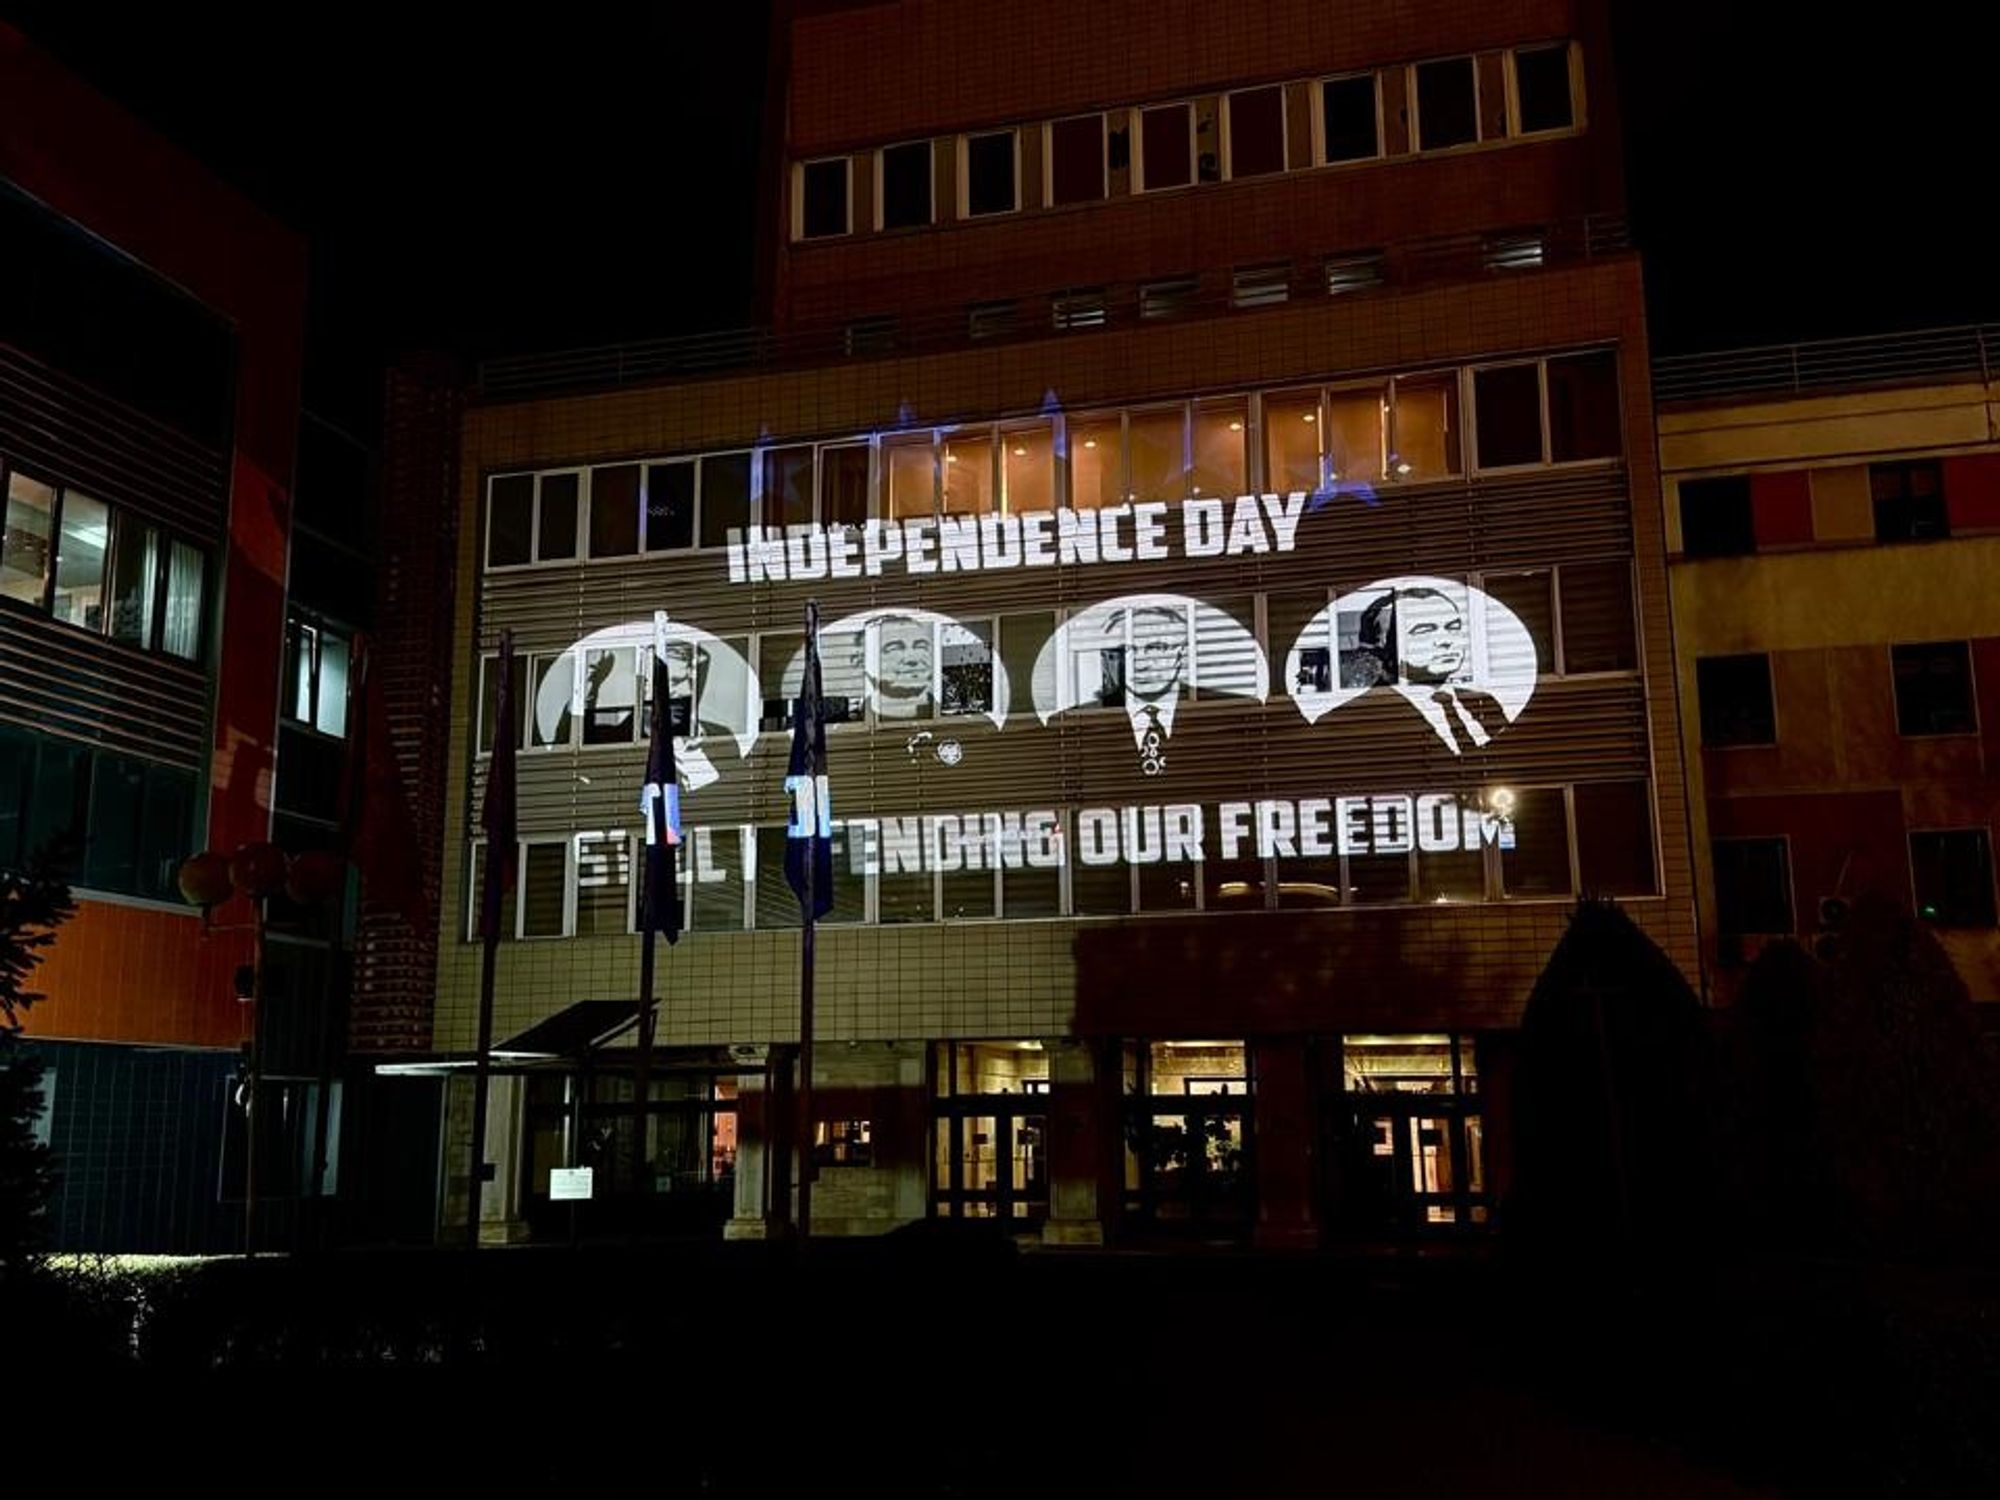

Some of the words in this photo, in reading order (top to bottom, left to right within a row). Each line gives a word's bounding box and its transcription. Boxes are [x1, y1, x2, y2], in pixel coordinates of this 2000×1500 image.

[727, 502, 1169, 583] INDEPENDENCE
[1183, 493, 1306, 557] DAY
[1079, 804, 1206, 865] OUR
[1220, 795, 1515, 860] FREEDOM
